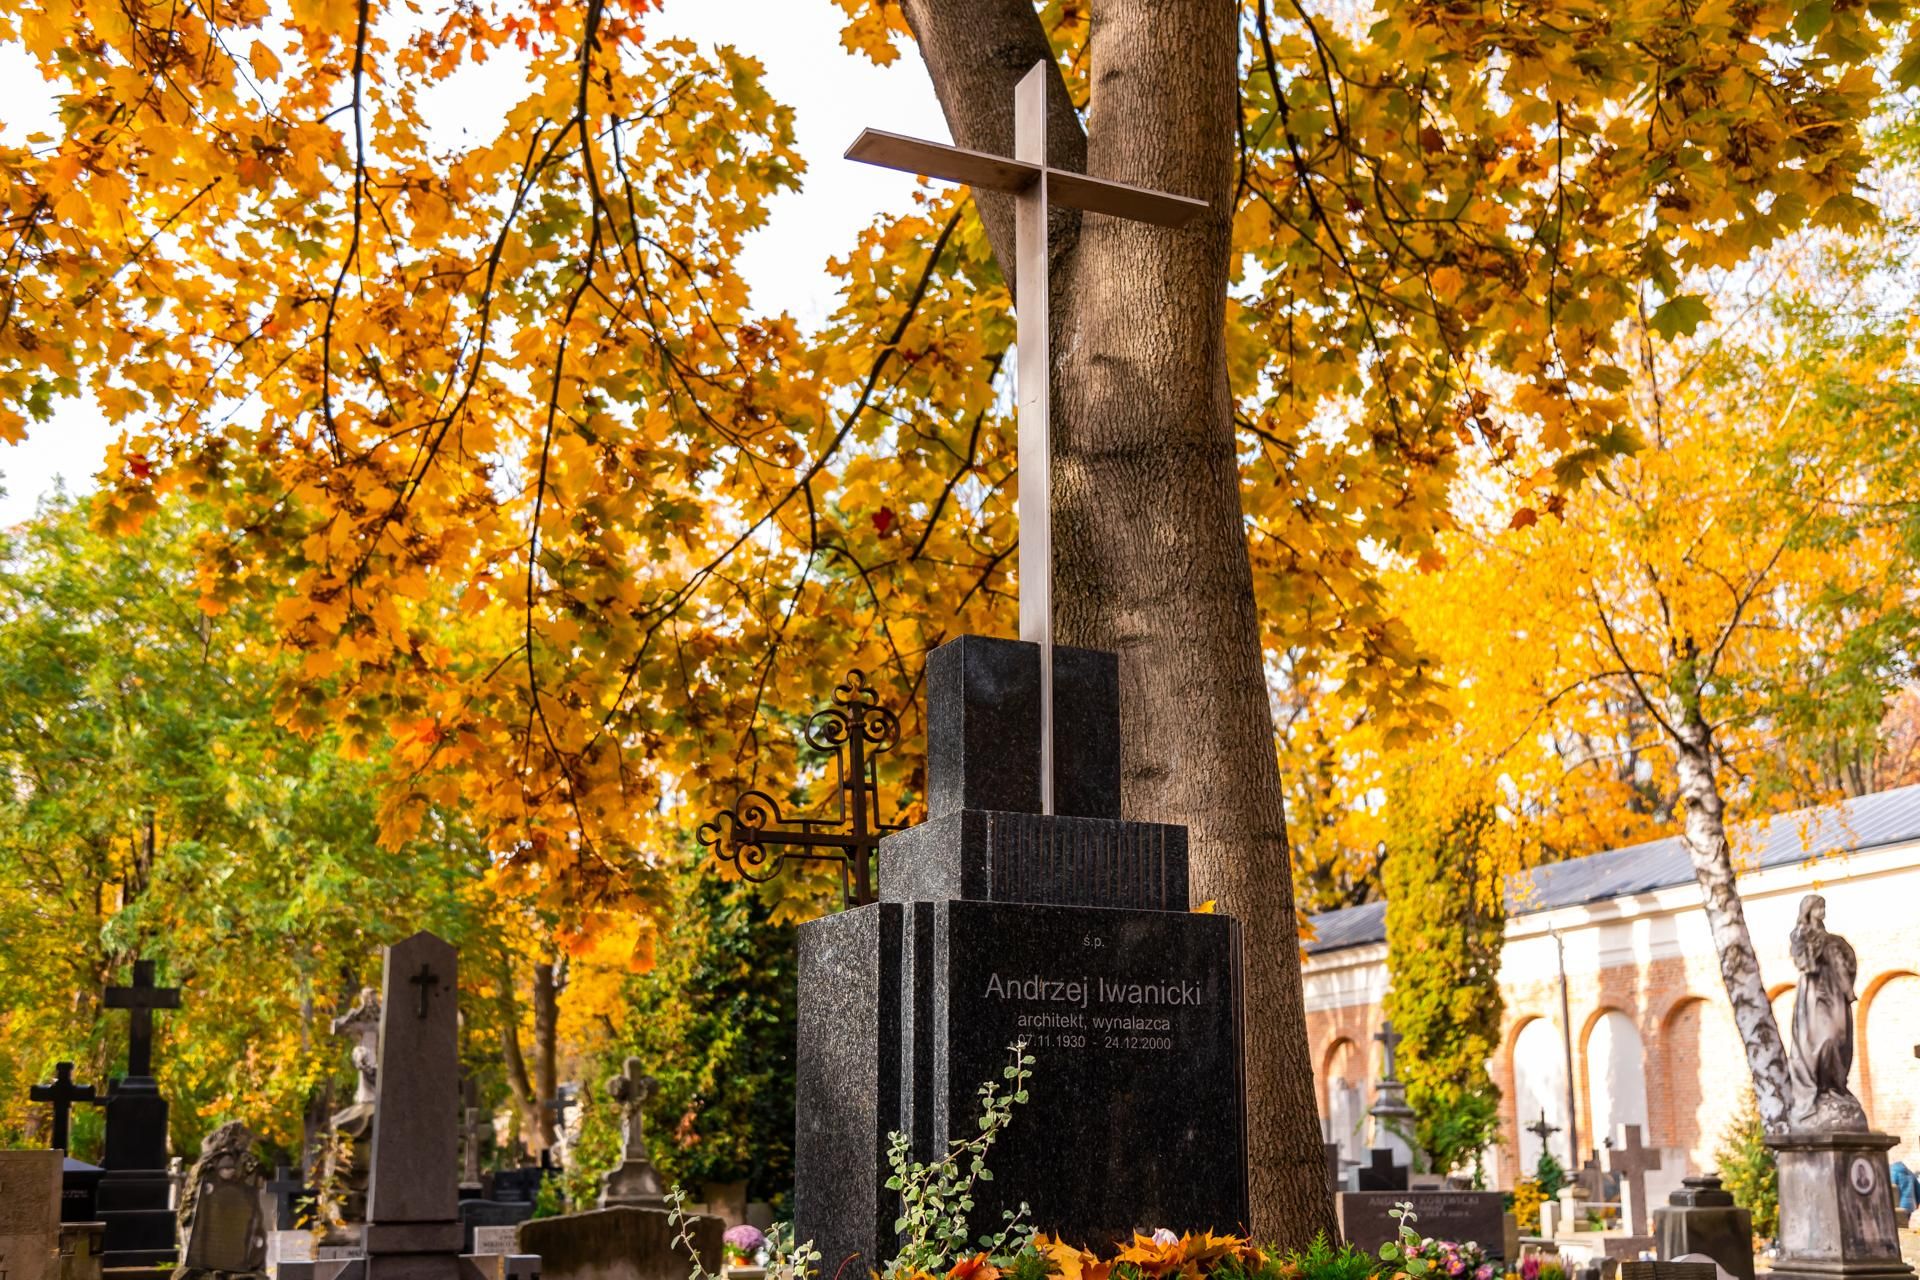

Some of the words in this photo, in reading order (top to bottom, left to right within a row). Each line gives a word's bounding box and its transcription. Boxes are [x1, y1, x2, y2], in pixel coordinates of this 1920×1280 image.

[1083, 934, 1105, 949] ś.p.
[984, 972, 1088, 1009] Andrzej
[1099, 976, 1201, 1005] Iwanicki
[1018, 1012, 1087, 1031] architekt,
[1092, 1015, 1170, 1033] wynalazca
[1018, 1033, 1086, 1048] 07.11.1930
[1104, 1036, 1171, 1050] 24.12.2000
